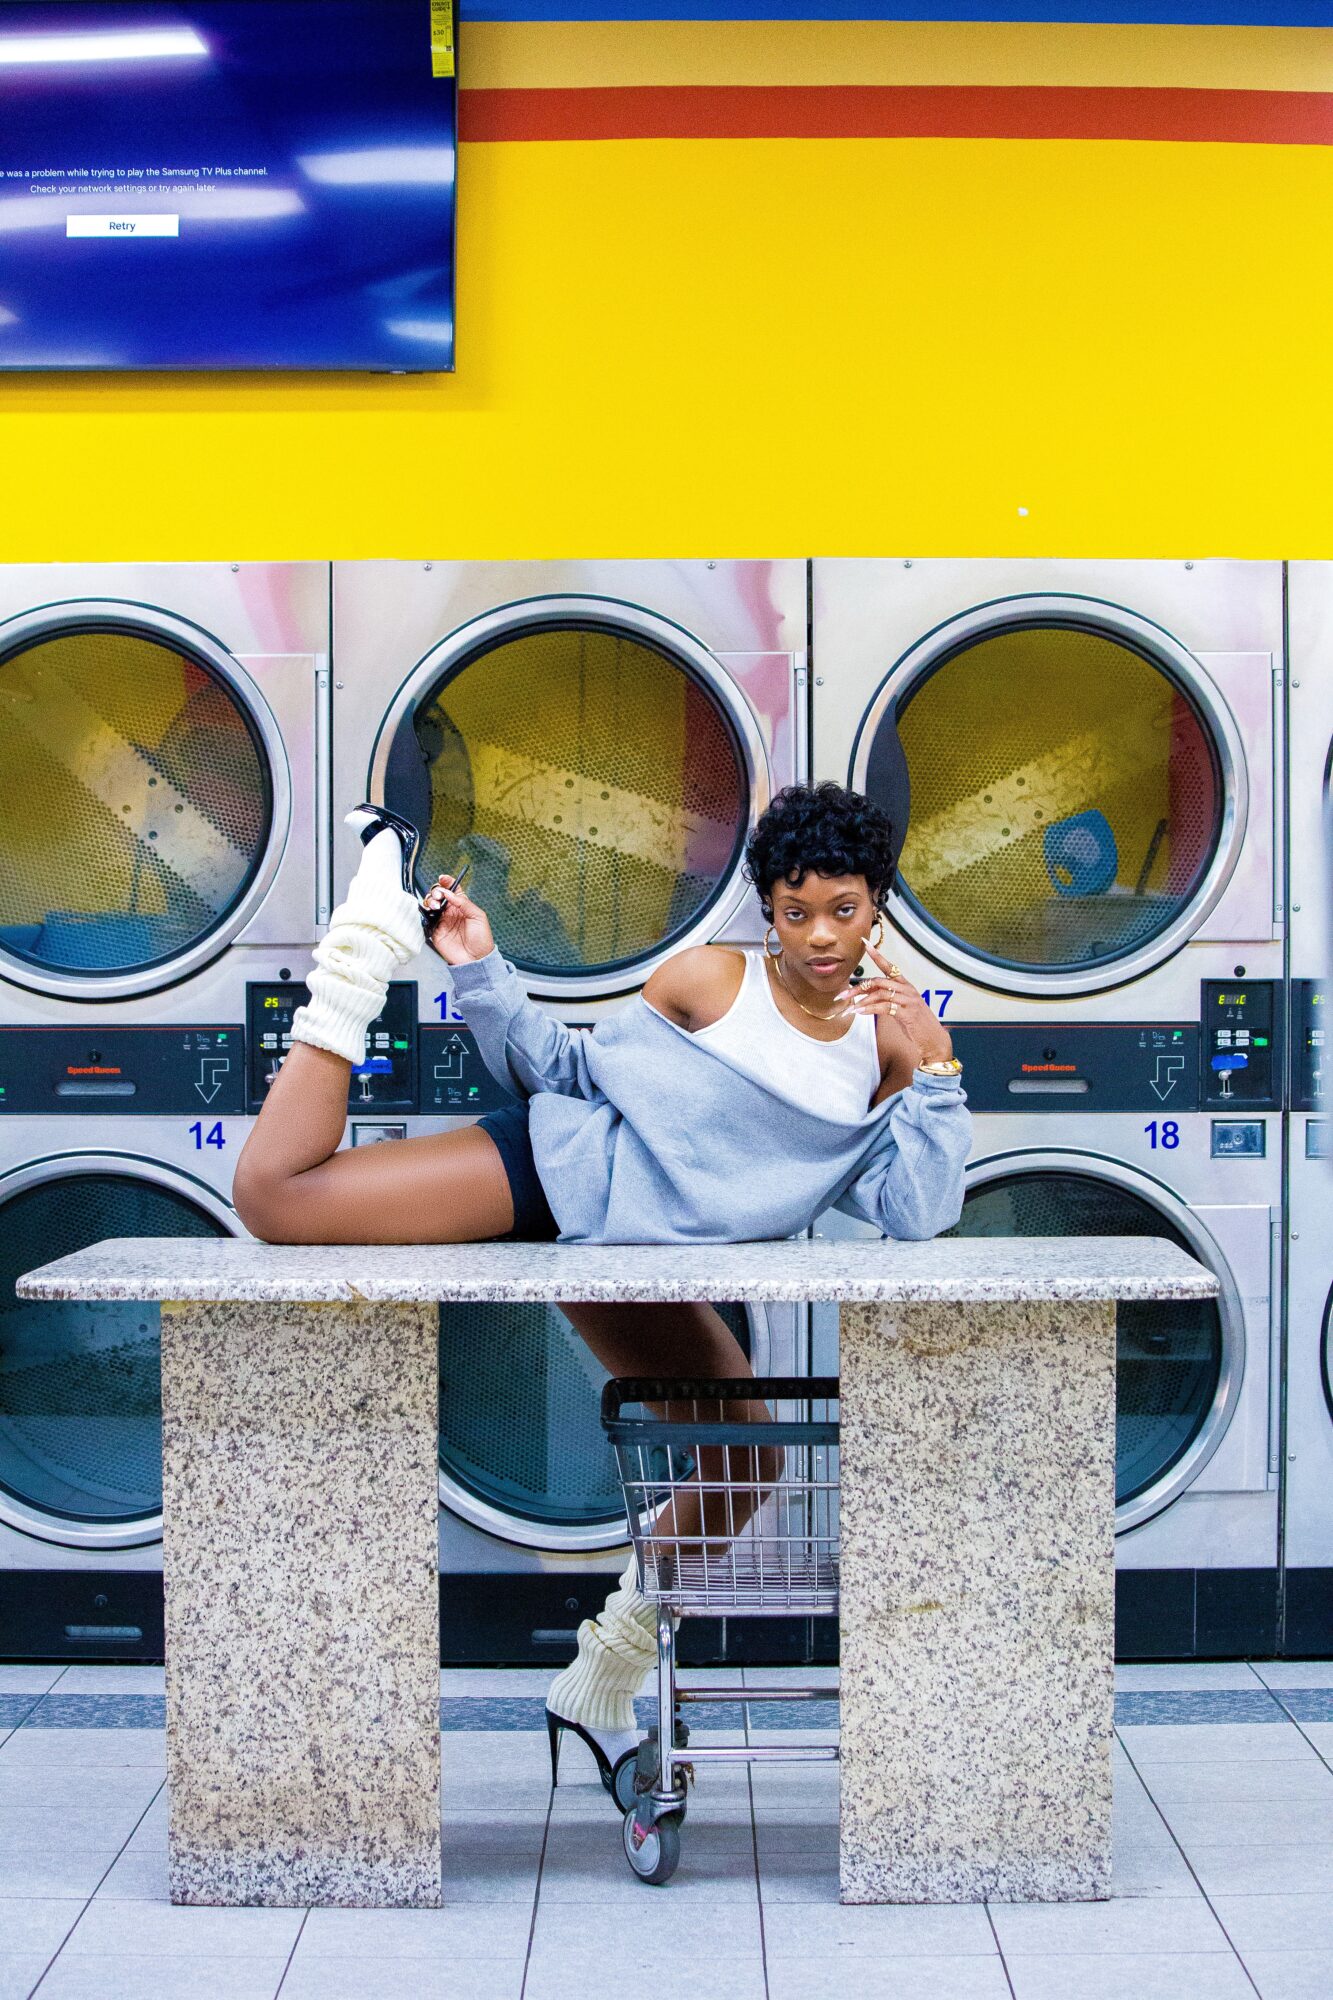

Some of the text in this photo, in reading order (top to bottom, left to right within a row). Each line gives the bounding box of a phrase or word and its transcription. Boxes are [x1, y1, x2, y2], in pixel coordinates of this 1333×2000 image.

[7, 170, 23, 178] was
[31, 168, 65, 179] problem
[67, 168, 89, 177] while
[91, 168, 115, 179] trying
[117, 168, 126, 177] to
[127, 168, 144, 179] play
[146, 168, 160, 177] the
[162, 167, 200, 178] Samsung
[201, 167, 213, 176] TV
[215, 167, 232, 176] Plus
[234, 166, 268, 176] channel.
[30, 183, 217, 195] Check your network settings or try again later.
[109, 221, 136, 233] Retry
[264, 997, 279, 1008] 25
[921, 989, 953, 1018] 17
[67, 1066, 121, 1076] Speed Queen
[1021, 1063, 1076, 1073] Speed Queen
[189, 1121, 226, 1150] 14
[1144, 1120, 1180, 1150] 18
